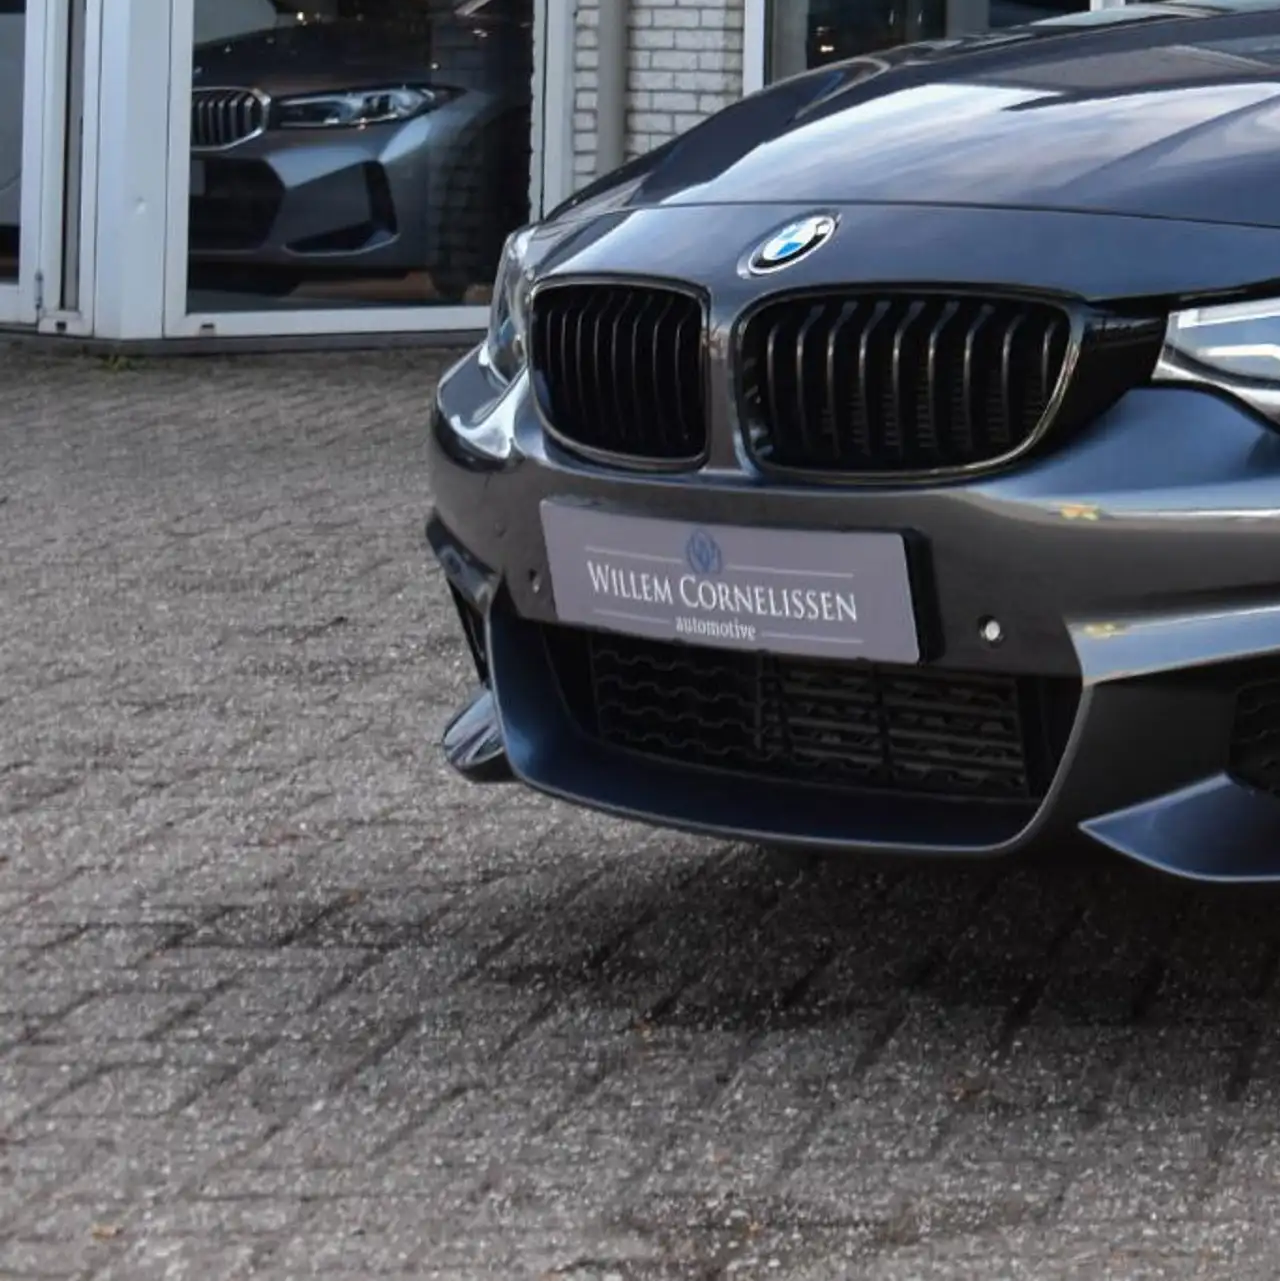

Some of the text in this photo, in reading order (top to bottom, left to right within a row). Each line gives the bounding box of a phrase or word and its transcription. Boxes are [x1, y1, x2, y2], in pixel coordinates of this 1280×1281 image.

[586, 559, 858, 623] WILLEM CORNELISSEN
[675, 615, 757, 642] automotive
